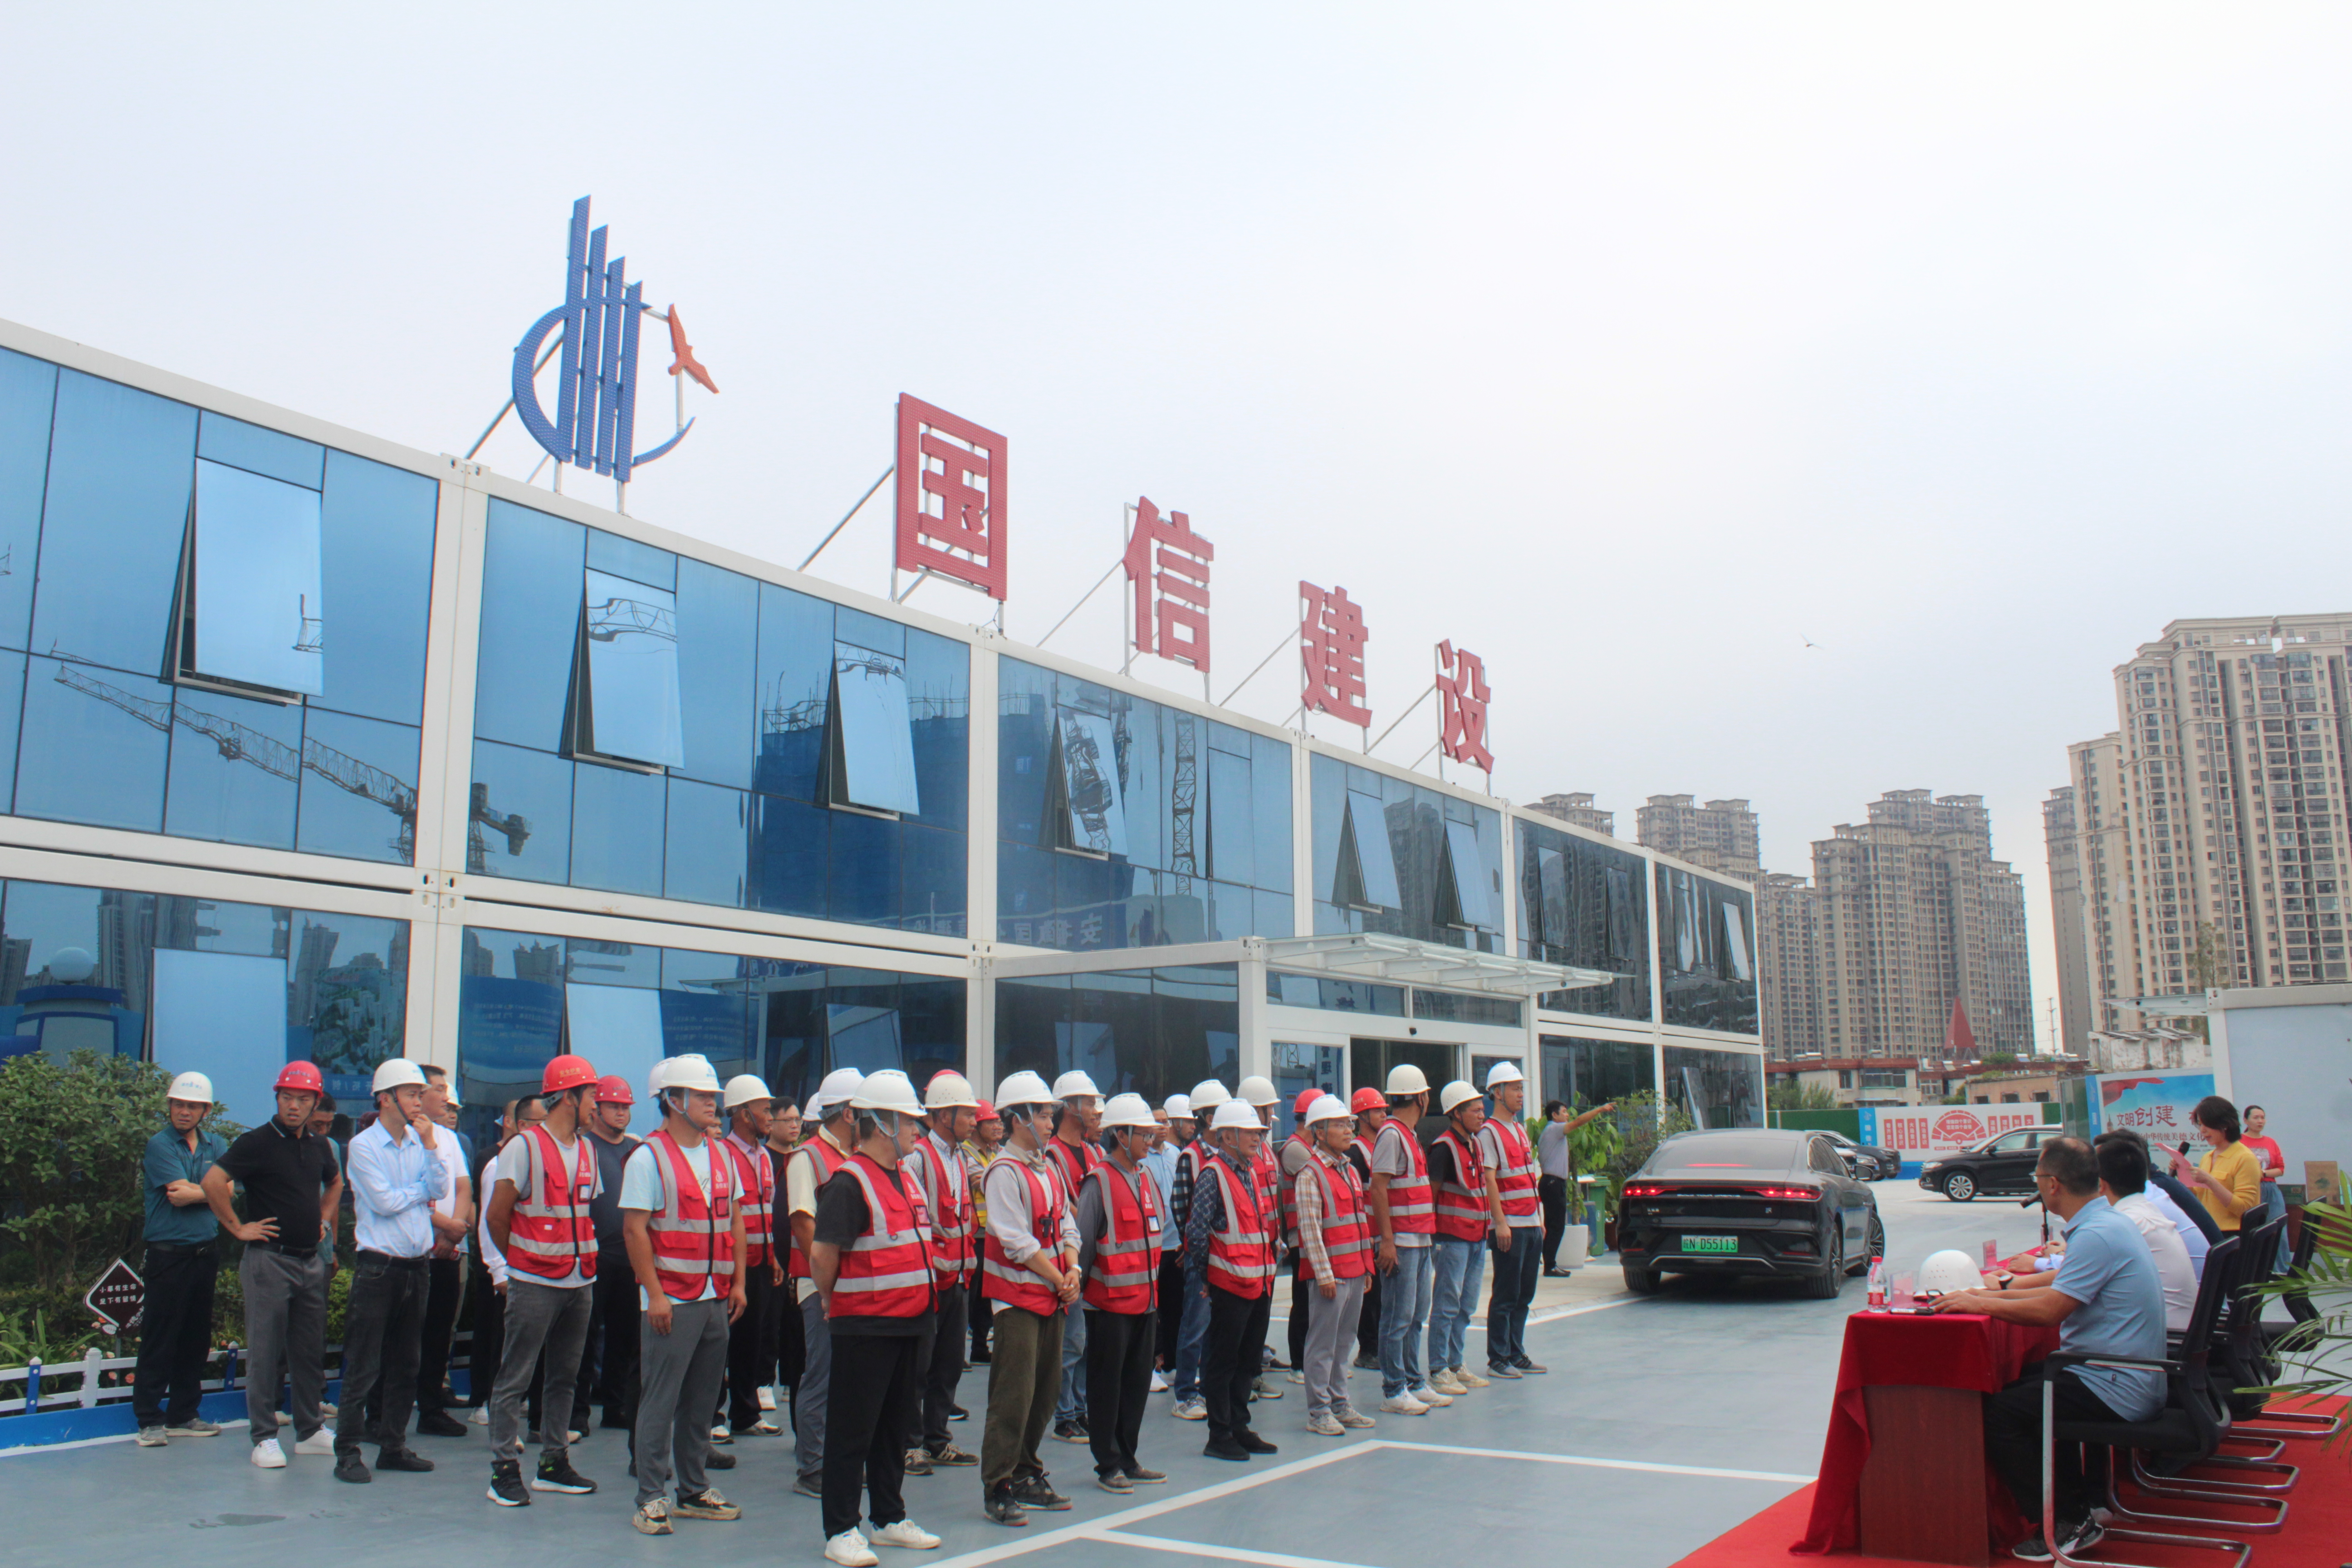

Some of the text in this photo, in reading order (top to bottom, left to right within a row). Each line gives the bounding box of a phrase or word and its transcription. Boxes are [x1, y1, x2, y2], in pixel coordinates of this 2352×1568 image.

[896, 392, 1494, 774] 国信建设
[2117, 1105, 2177, 1127] 文明创建
[1700, 1238, 1736, 1250] D55113
[99, 1284, 137, 1293] 小草有生命
[99, 1295, 137, 1305] 足下有留情
